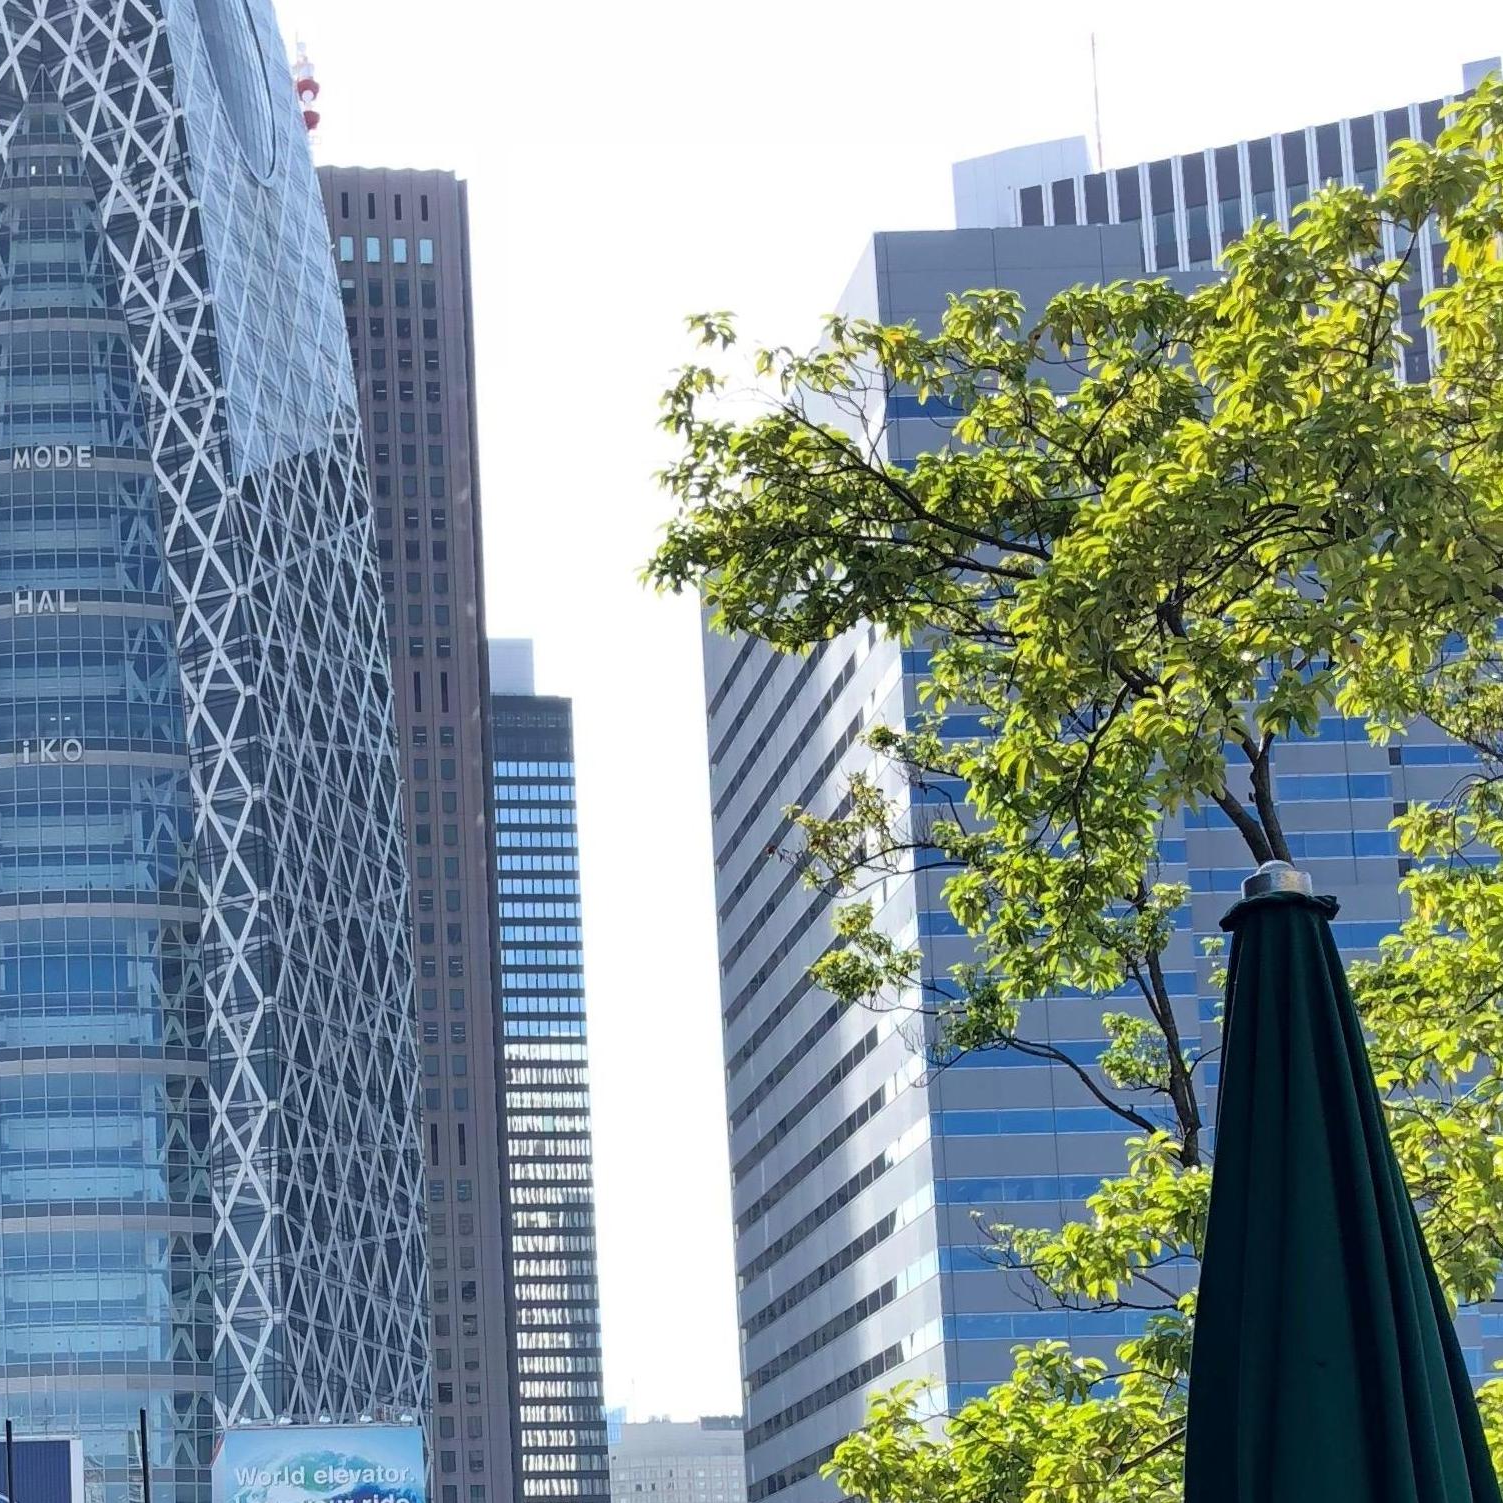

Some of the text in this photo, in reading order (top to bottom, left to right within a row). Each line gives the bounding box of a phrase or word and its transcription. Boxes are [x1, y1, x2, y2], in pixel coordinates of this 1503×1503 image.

[12, 445, 92, 470] MODE
[14, 589, 78, 614] HAL
[235, 1464, 415, 1487] World elevator.
